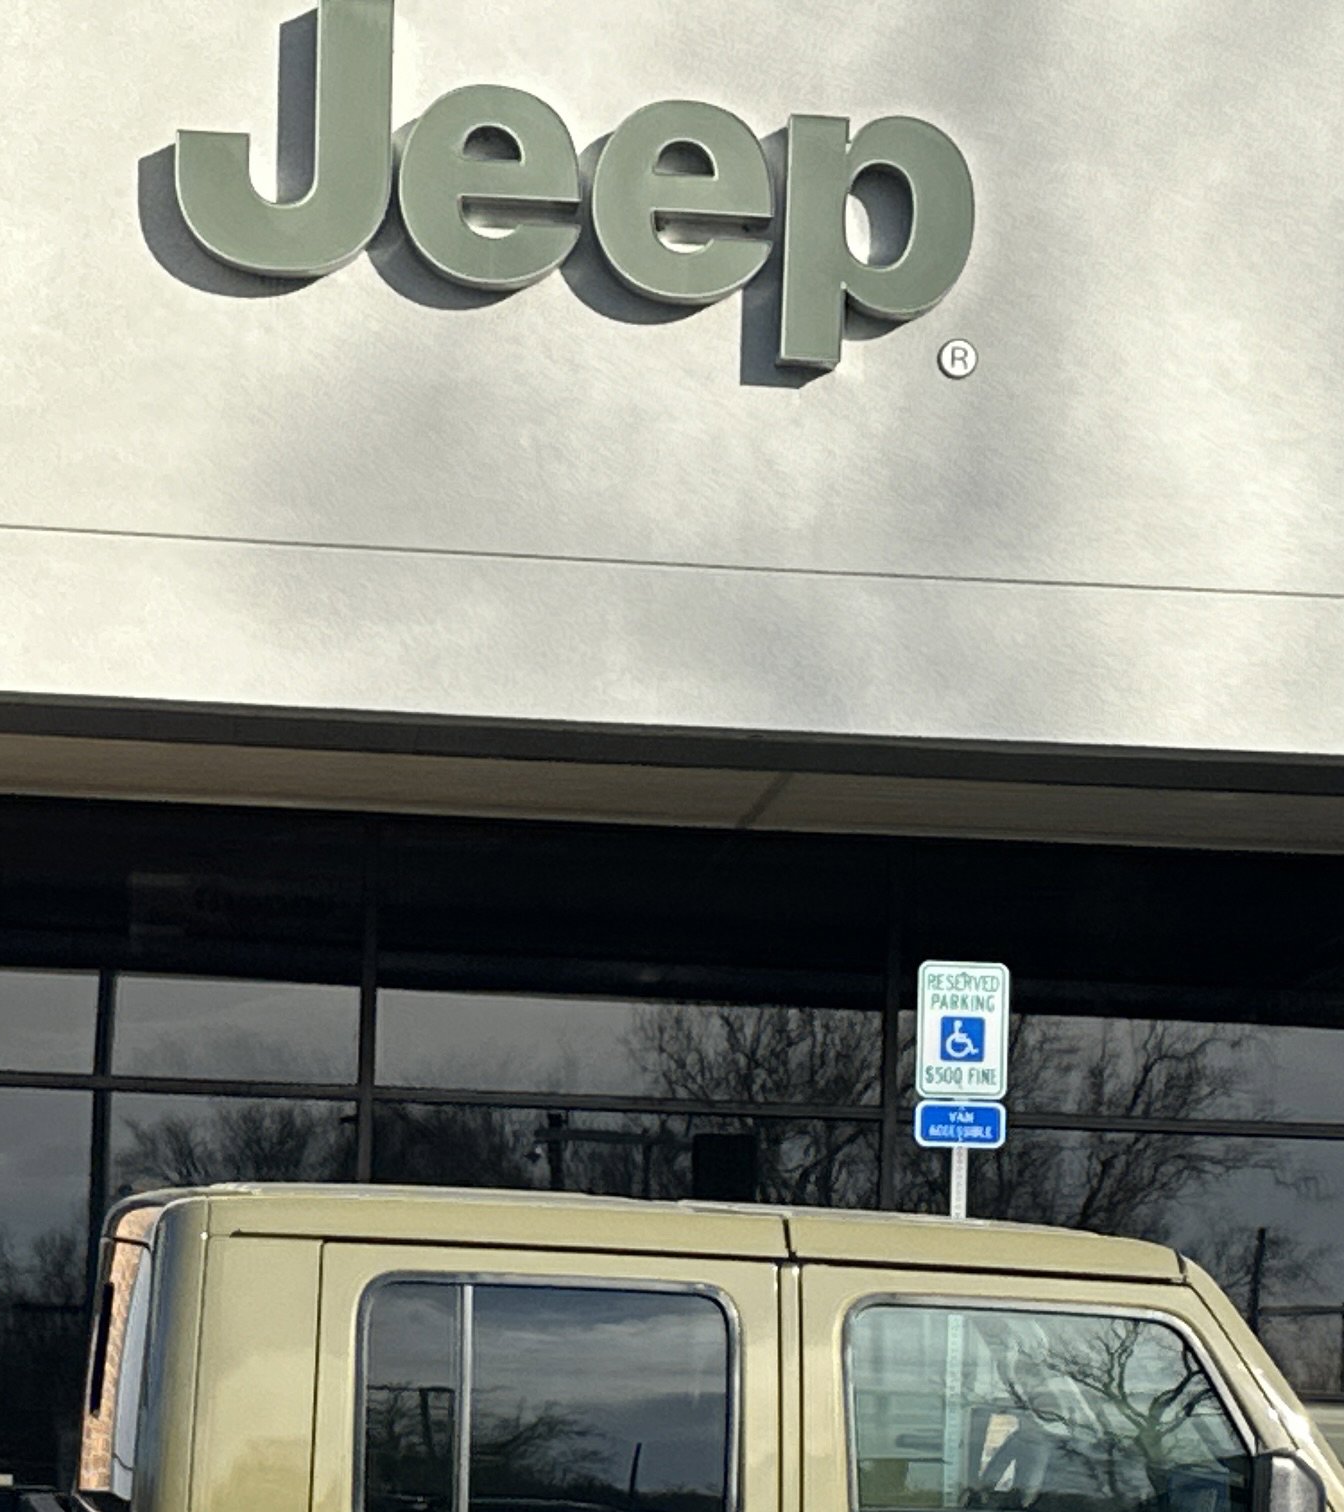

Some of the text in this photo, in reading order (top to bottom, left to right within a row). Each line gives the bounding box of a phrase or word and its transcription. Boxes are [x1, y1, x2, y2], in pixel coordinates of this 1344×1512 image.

[175, 0, 976, 370] Jeep
[927, 974, 999, 992] RESERVED
[930, 994, 996, 1012] PARKING
[925, 1066, 998, 1085] $500 FINE
[949, 1112, 975, 1123] VAN
